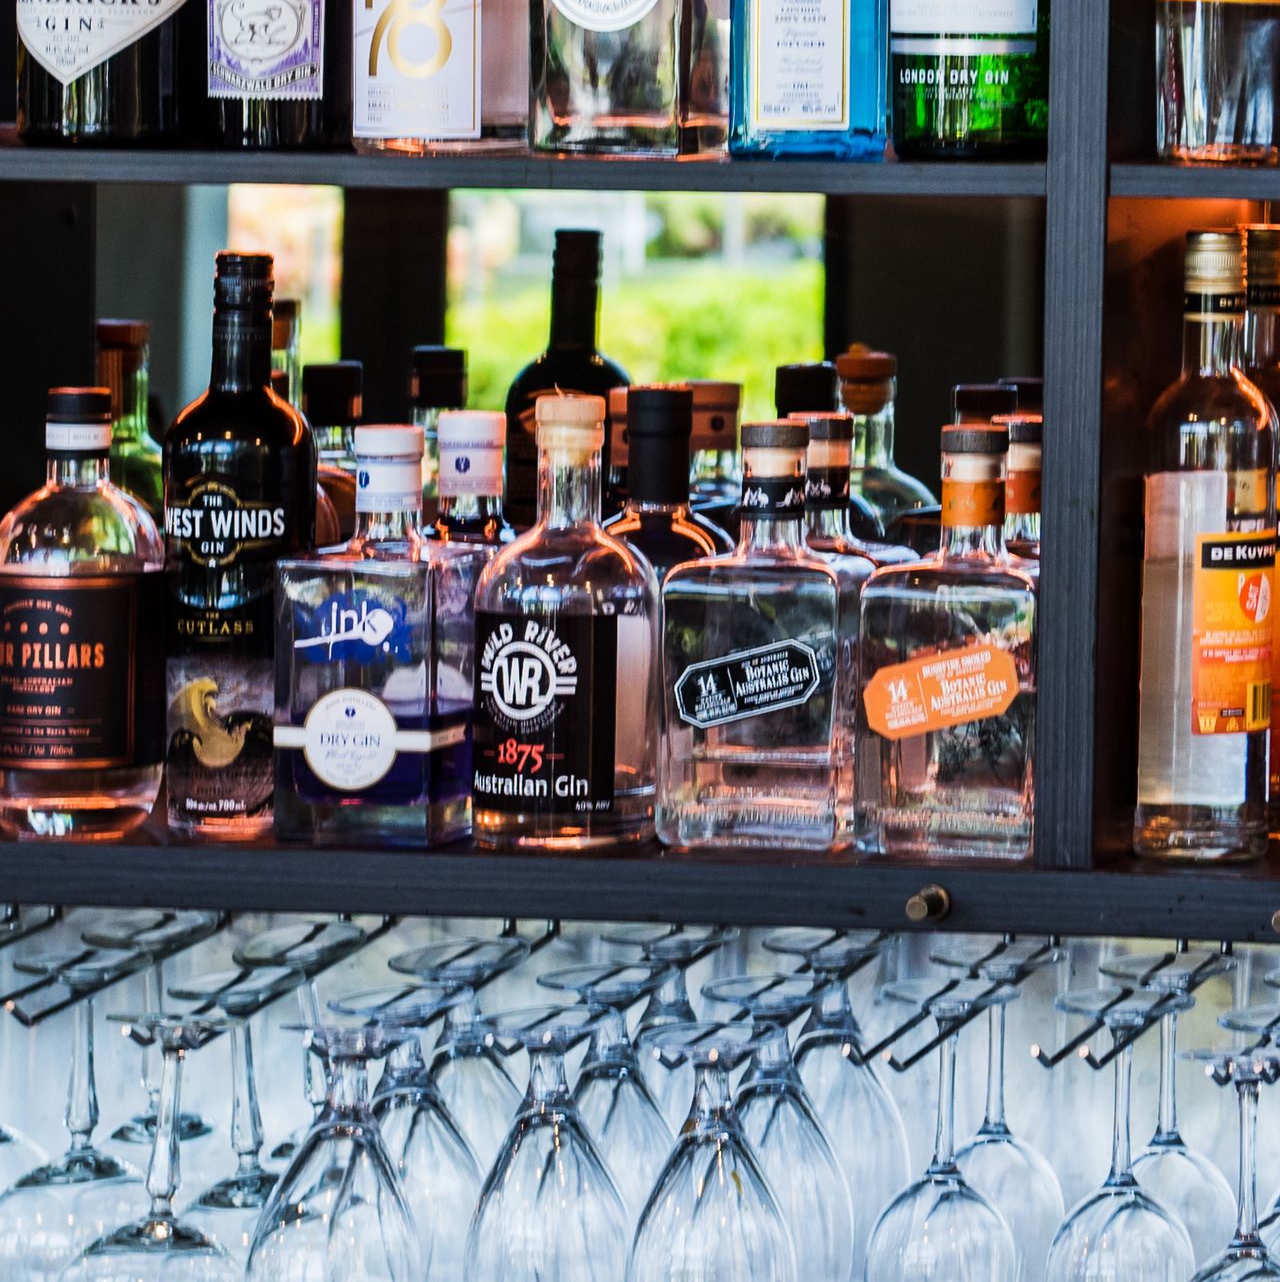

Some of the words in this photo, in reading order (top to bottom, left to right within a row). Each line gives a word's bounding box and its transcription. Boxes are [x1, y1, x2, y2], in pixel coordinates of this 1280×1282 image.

[45, 17, 92, 31] GIN
[211, 64, 272, 92] SCHWARZWALD
[273, 72, 294, 87] DRY
[900, 69, 945, 84] LONDON
[949, 69, 978, 85] DRY
[985, 69, 1009, 85] GIN
[203, 495, 222, 507] THE
[165, 508, 203, 538] WEST
[211, 508, 285, 538] WINDS
[201, 541, 224, 554] GIN
[1211, 547, 1233, 561] DE
[1236, 545, 1275, 560] KUYPE
[178, 619, 253, 635] CUTLASS
[22, 642, 105, 669] PILLARS
[481, 622, 514, 670] WILD
[524, 620, 578, 674] RIVER
[961, 651, 991, 668] SMOKED
[501, 657, 547, 705] WR
[697, 673, 717, 696] 14
[887, 678, 908, 703] 14
[27, 705, 43, 715] DRY
[45, 705, 61, 716] GIN
[320, 733, 348, 747] DRY
[352, 733, 381, 748] GIN
[498, 738, 544, 773] 1875
[474, 770, 547, 797] Australian
[555, 775, 589, 797] Gin
[595, 799, 611, 810] ABV
